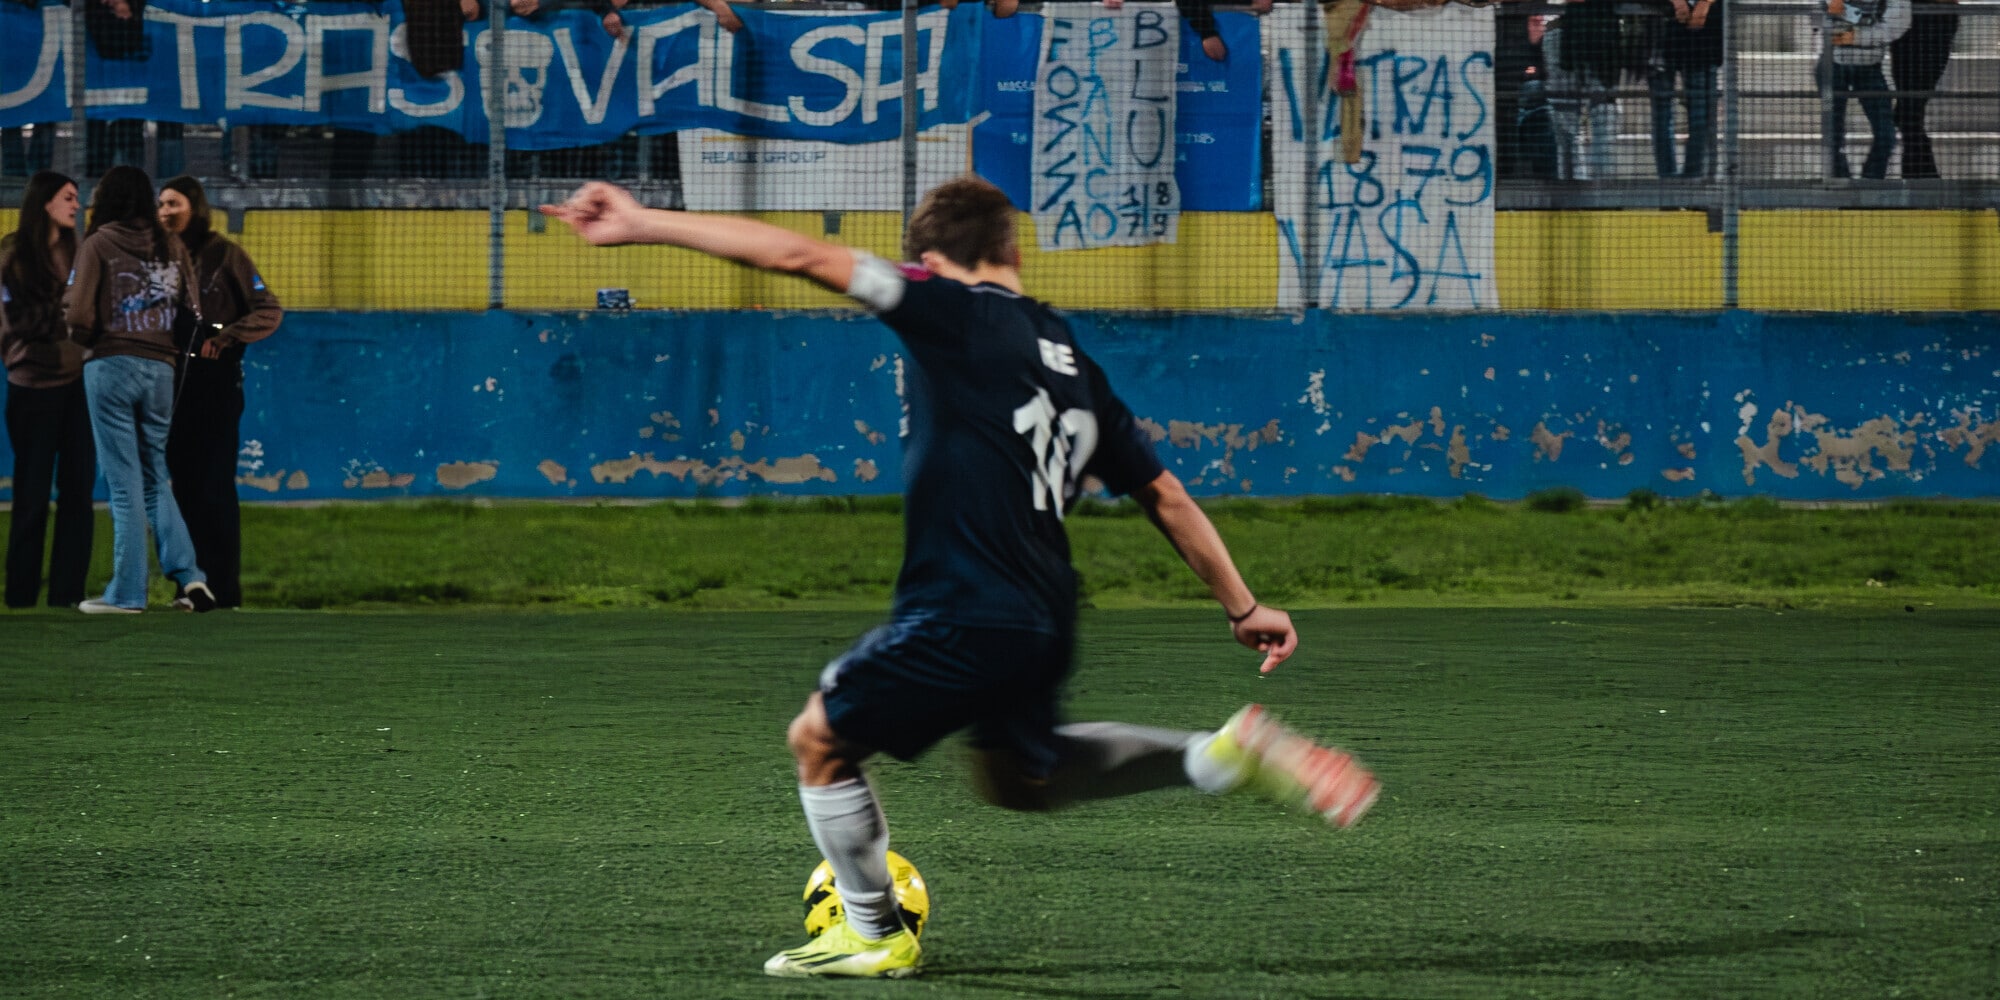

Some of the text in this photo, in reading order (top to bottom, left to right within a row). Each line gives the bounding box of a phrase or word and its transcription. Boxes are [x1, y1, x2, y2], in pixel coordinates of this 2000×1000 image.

[0, 4, 950, 126] ULTRAS VALSA
[1127, 10, 1169, 168] BLU
